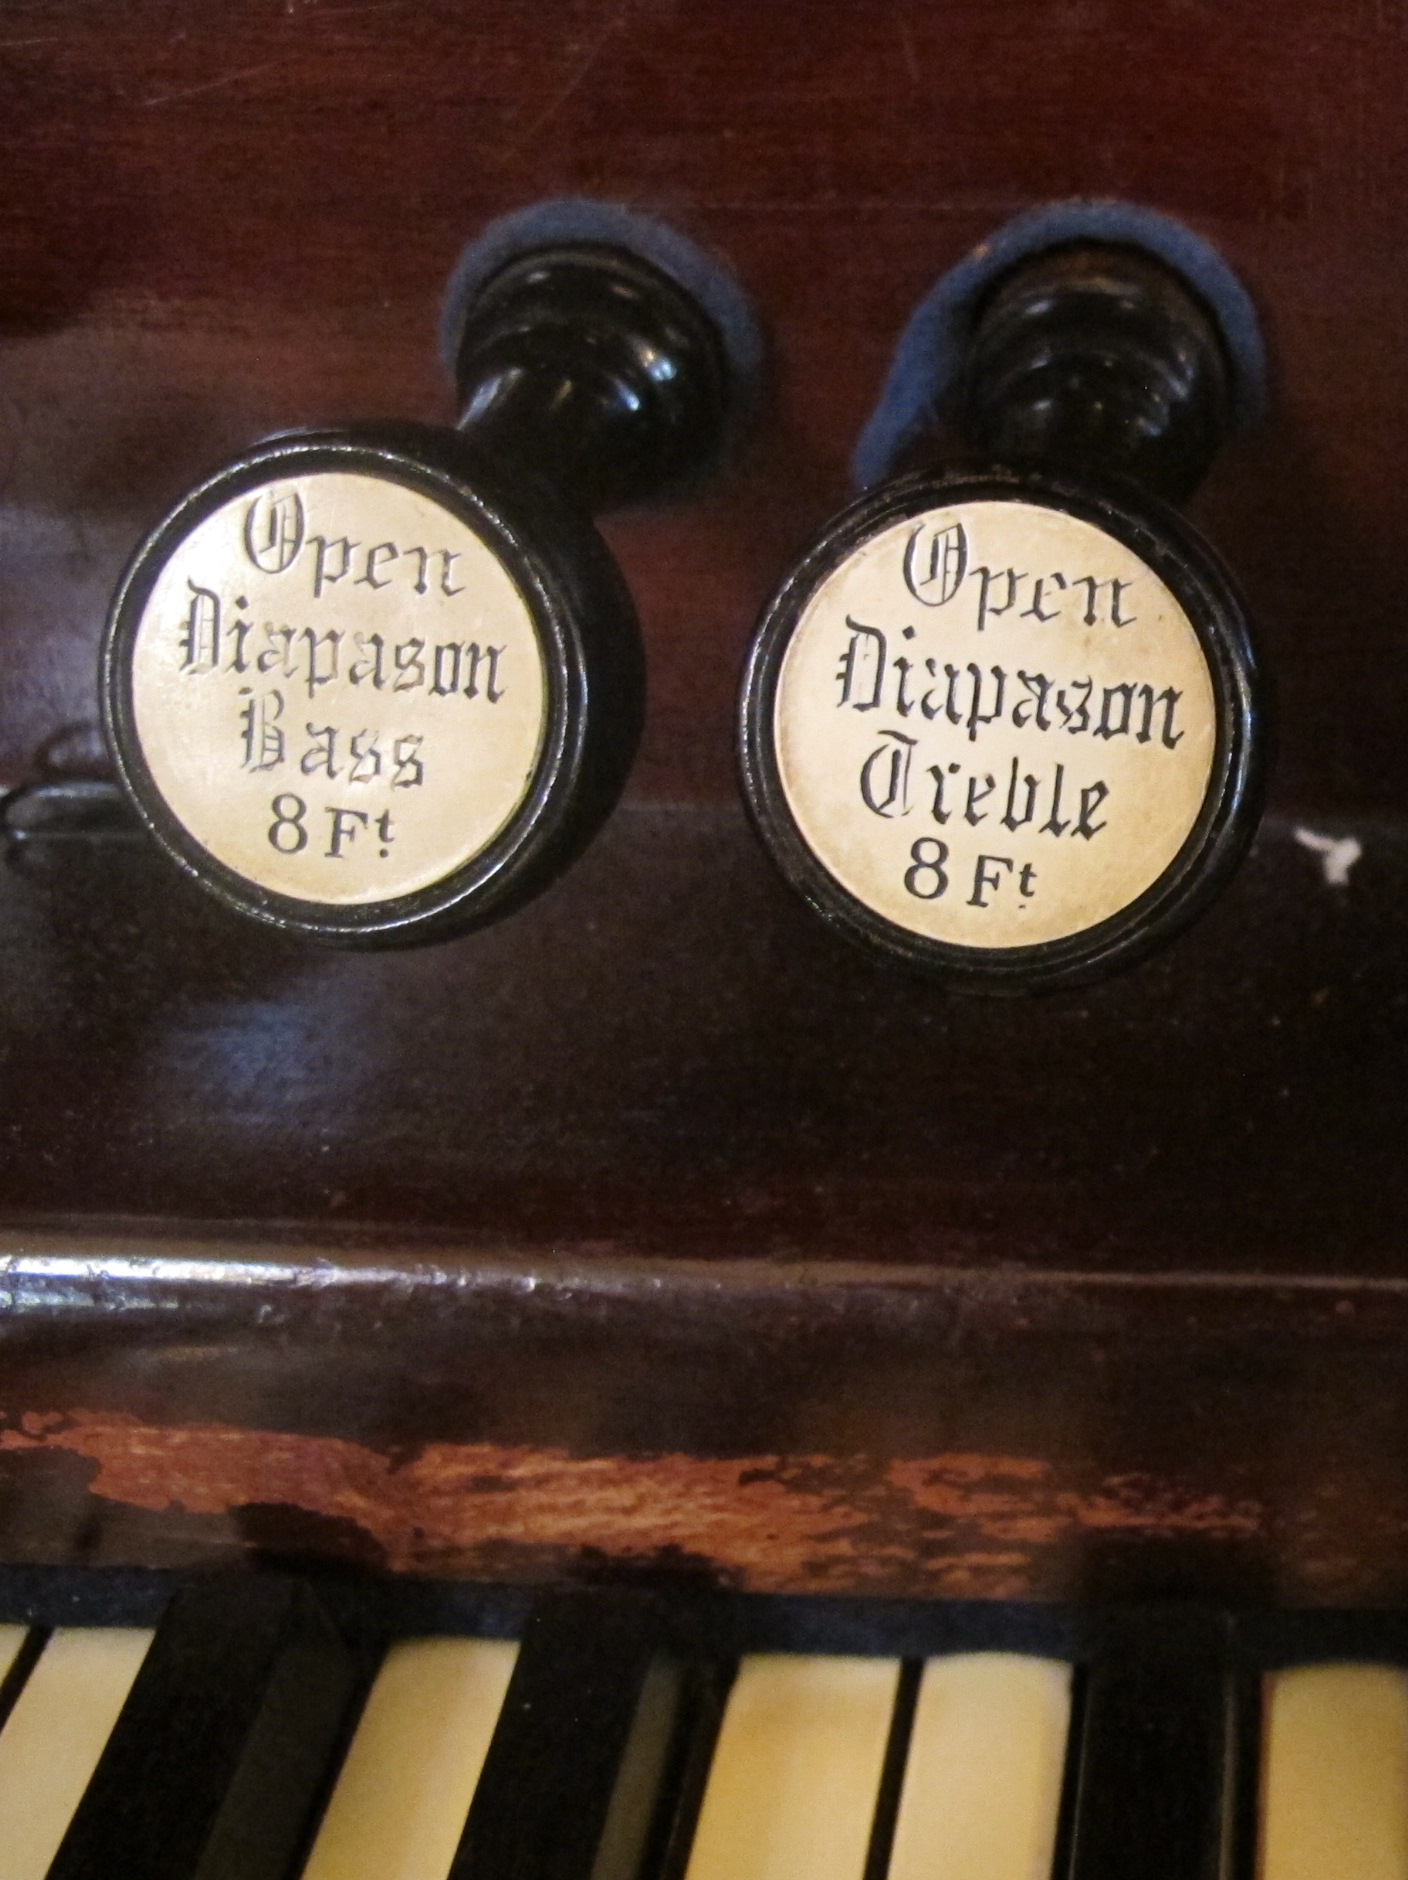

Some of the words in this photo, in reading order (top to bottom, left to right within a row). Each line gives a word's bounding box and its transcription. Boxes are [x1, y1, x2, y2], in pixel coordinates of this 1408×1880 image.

[244, 489, 466, 598] Open
[903, 522, 1137, 631] Open
[179, 576, 507, 703] Diapason
[836, 614, 1184, 750] Diapason
[240, 687, 424, 789] Bass
[859, 730, 1111, 841] Treble
[268, 792, 309, 854] 8
[903, 836, 950, 899] 8
